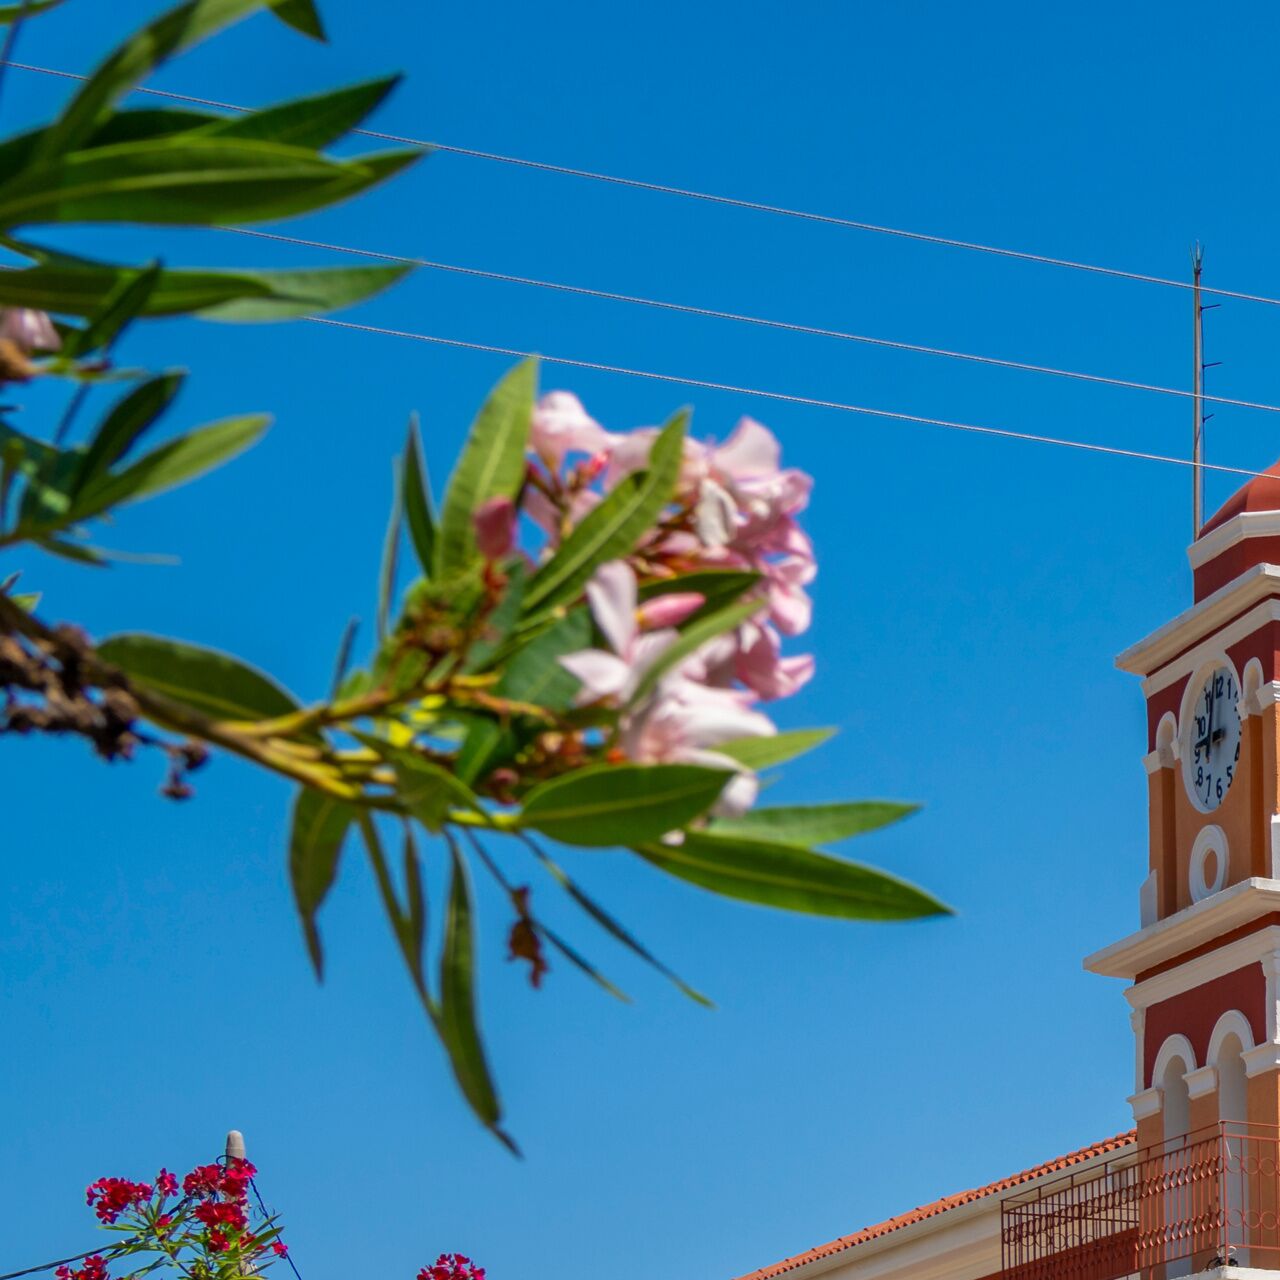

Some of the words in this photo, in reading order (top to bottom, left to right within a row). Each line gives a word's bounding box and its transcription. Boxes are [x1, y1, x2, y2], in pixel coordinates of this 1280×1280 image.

[1216, 676, 1223, 699] 12
[1227, 678, 1231, 699] 1
[1197, 716, 1206, 738] 10
[1197, 766, 1203, 787] 8
[1206, 775, 1211, 797] 7
[1226, 766, 1232, 788] 5
[1216, 778, 1222, 798] 6
